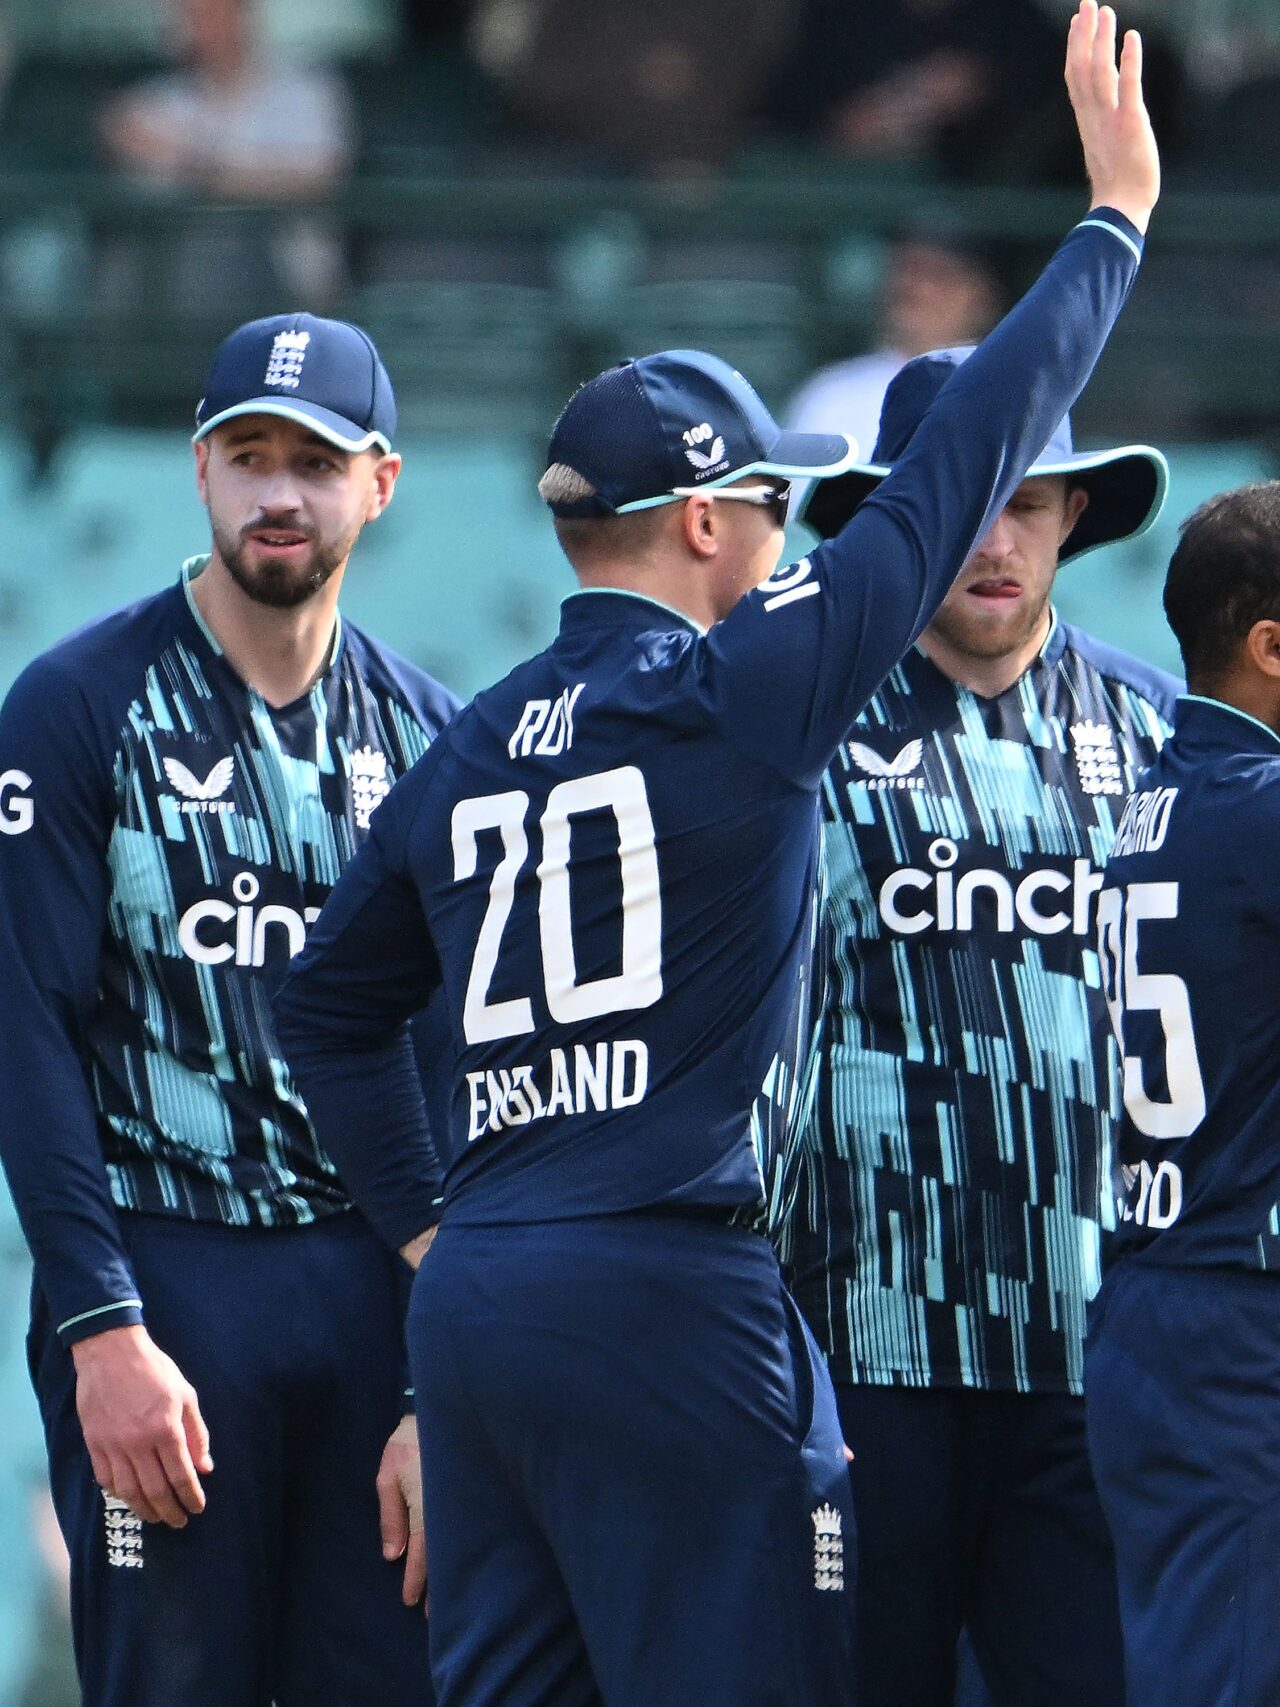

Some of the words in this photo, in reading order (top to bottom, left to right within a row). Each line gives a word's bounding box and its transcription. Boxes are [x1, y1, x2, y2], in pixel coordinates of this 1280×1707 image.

[683, 422, 714, 447] 100
[508, 683, 586, 760] ROY
[178, 871, 322, 967] cin
[451, 765, 663, 1045] 20
[465, 1039, 649, 1142] ENGLAND
